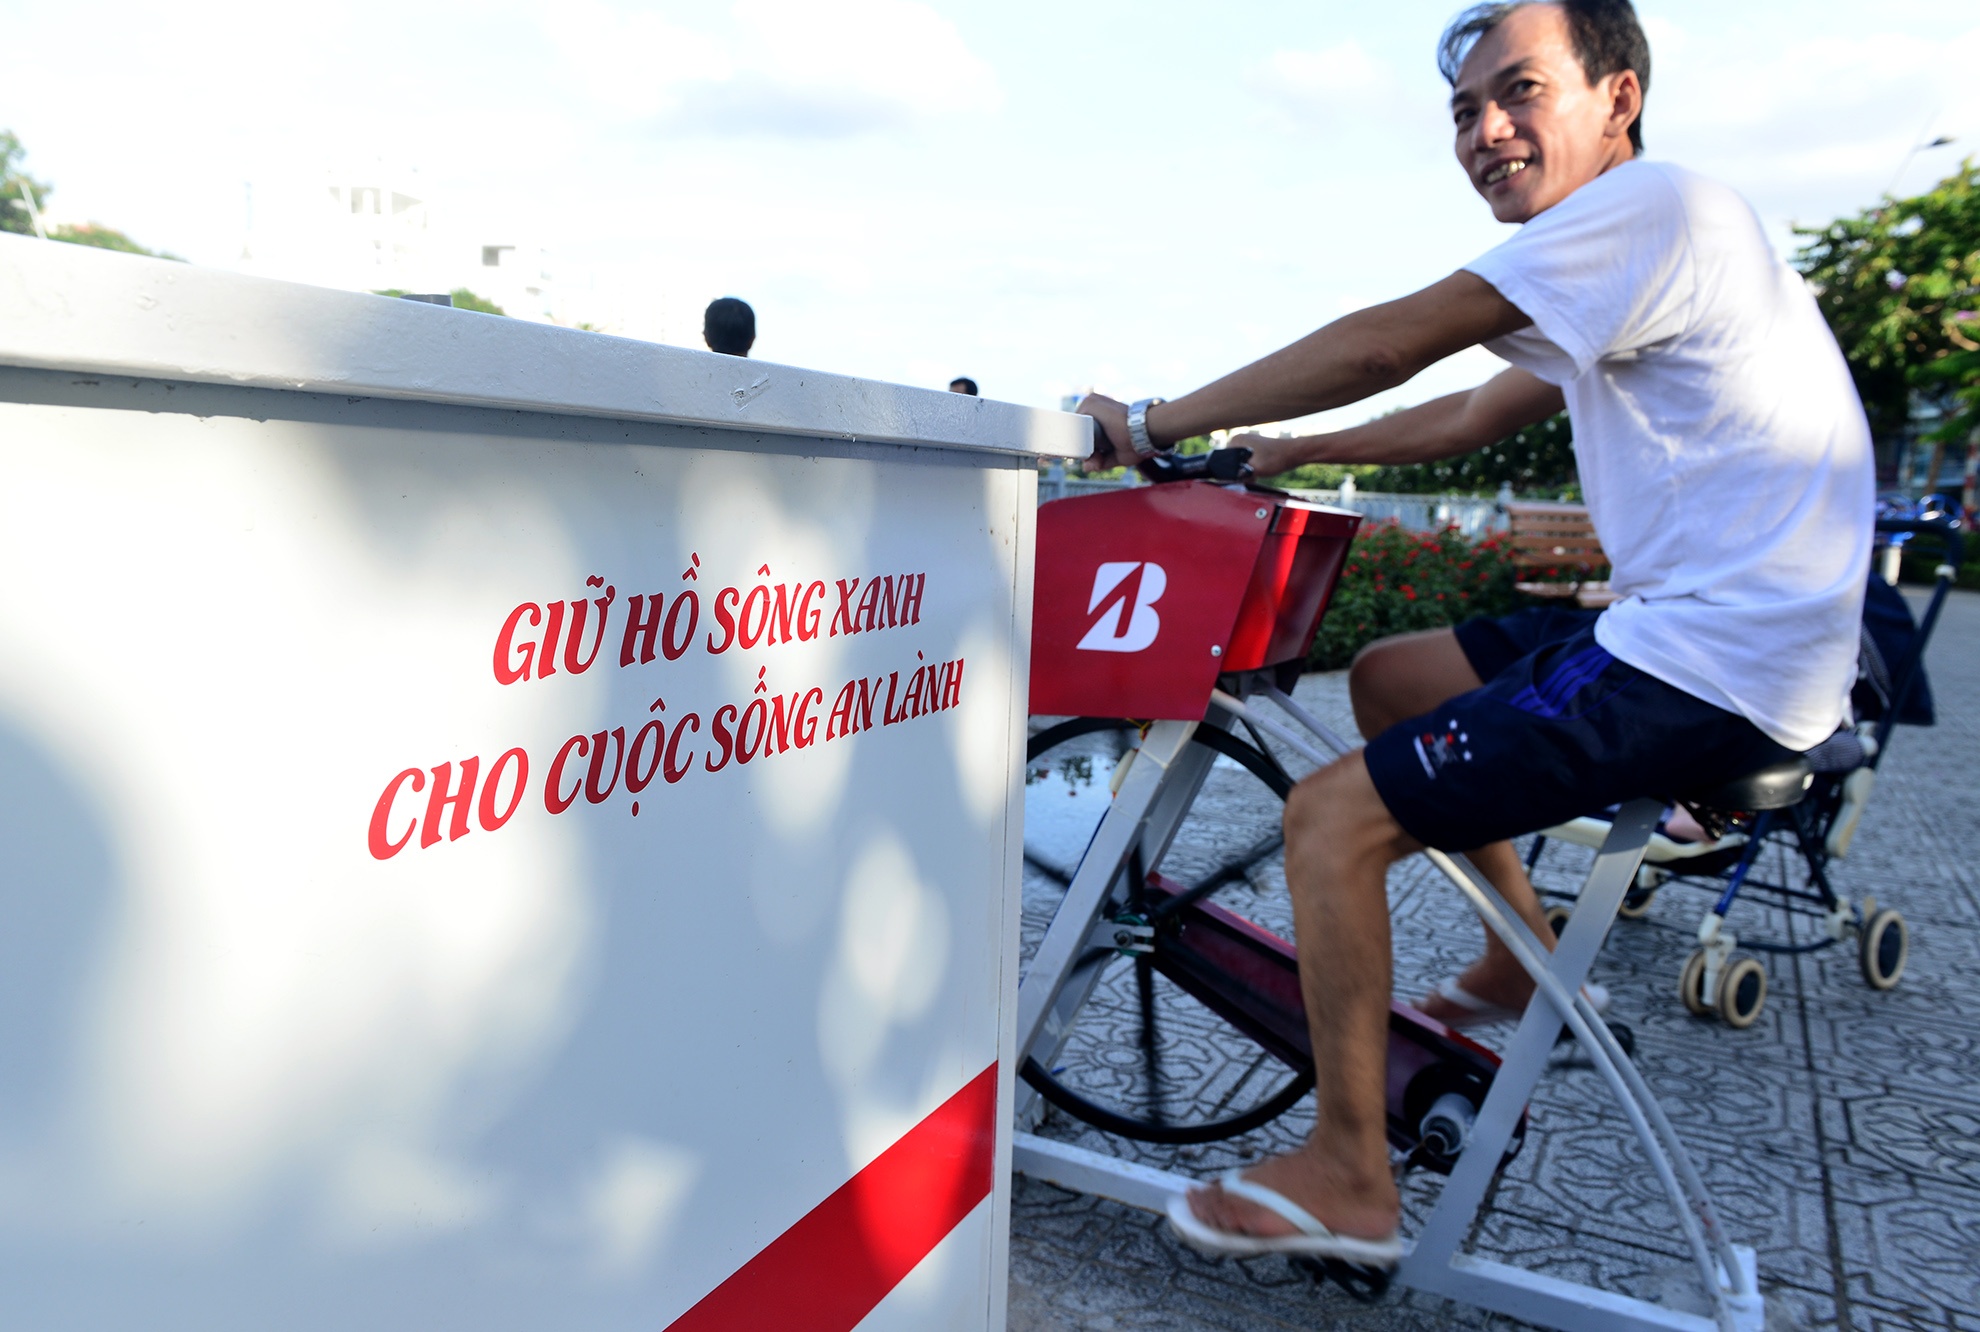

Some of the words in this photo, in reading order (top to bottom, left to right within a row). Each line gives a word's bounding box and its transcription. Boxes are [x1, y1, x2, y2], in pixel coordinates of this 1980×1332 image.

[493, 575, 615, 686] GIỮ
[620, 553, 700, 667] HỒ
[707, 564, 826, 656] SÔNG
[829, 572, 926, 637] XANH
[368, 747, 529, 861] CHO
[544, 698, 700, 817] CUỘC
[705, 666, 823, 772] SỐNG
[826, 676, 885, 742] AN
[884, 650, 965, 725] LÀNH
